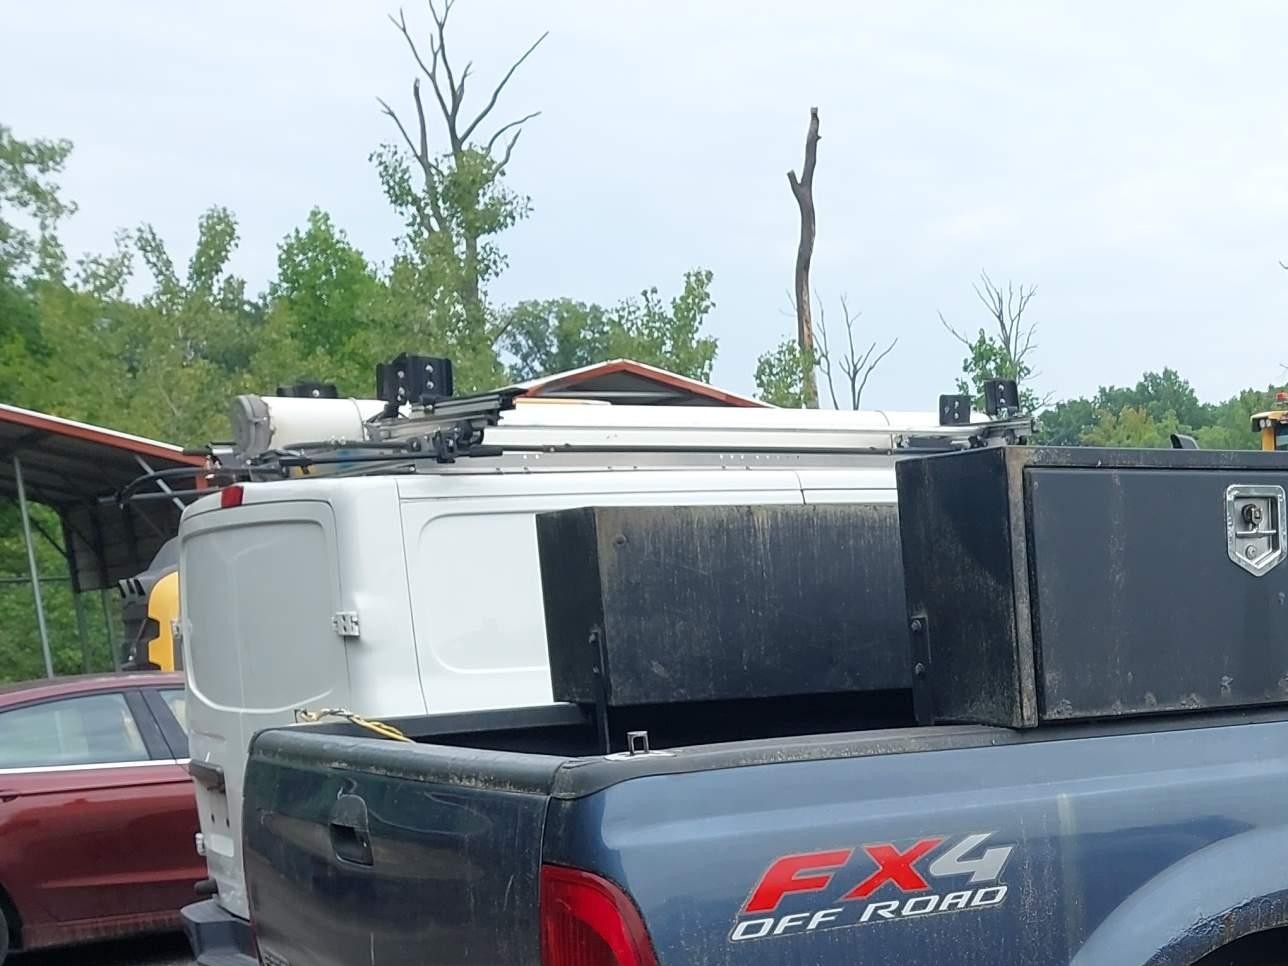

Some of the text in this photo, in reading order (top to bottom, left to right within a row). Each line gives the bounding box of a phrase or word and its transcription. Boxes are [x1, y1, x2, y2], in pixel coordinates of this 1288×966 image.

[744, 831, 1013, 913] FX4
[731, 885, 1009, 941] OFF ROAD
